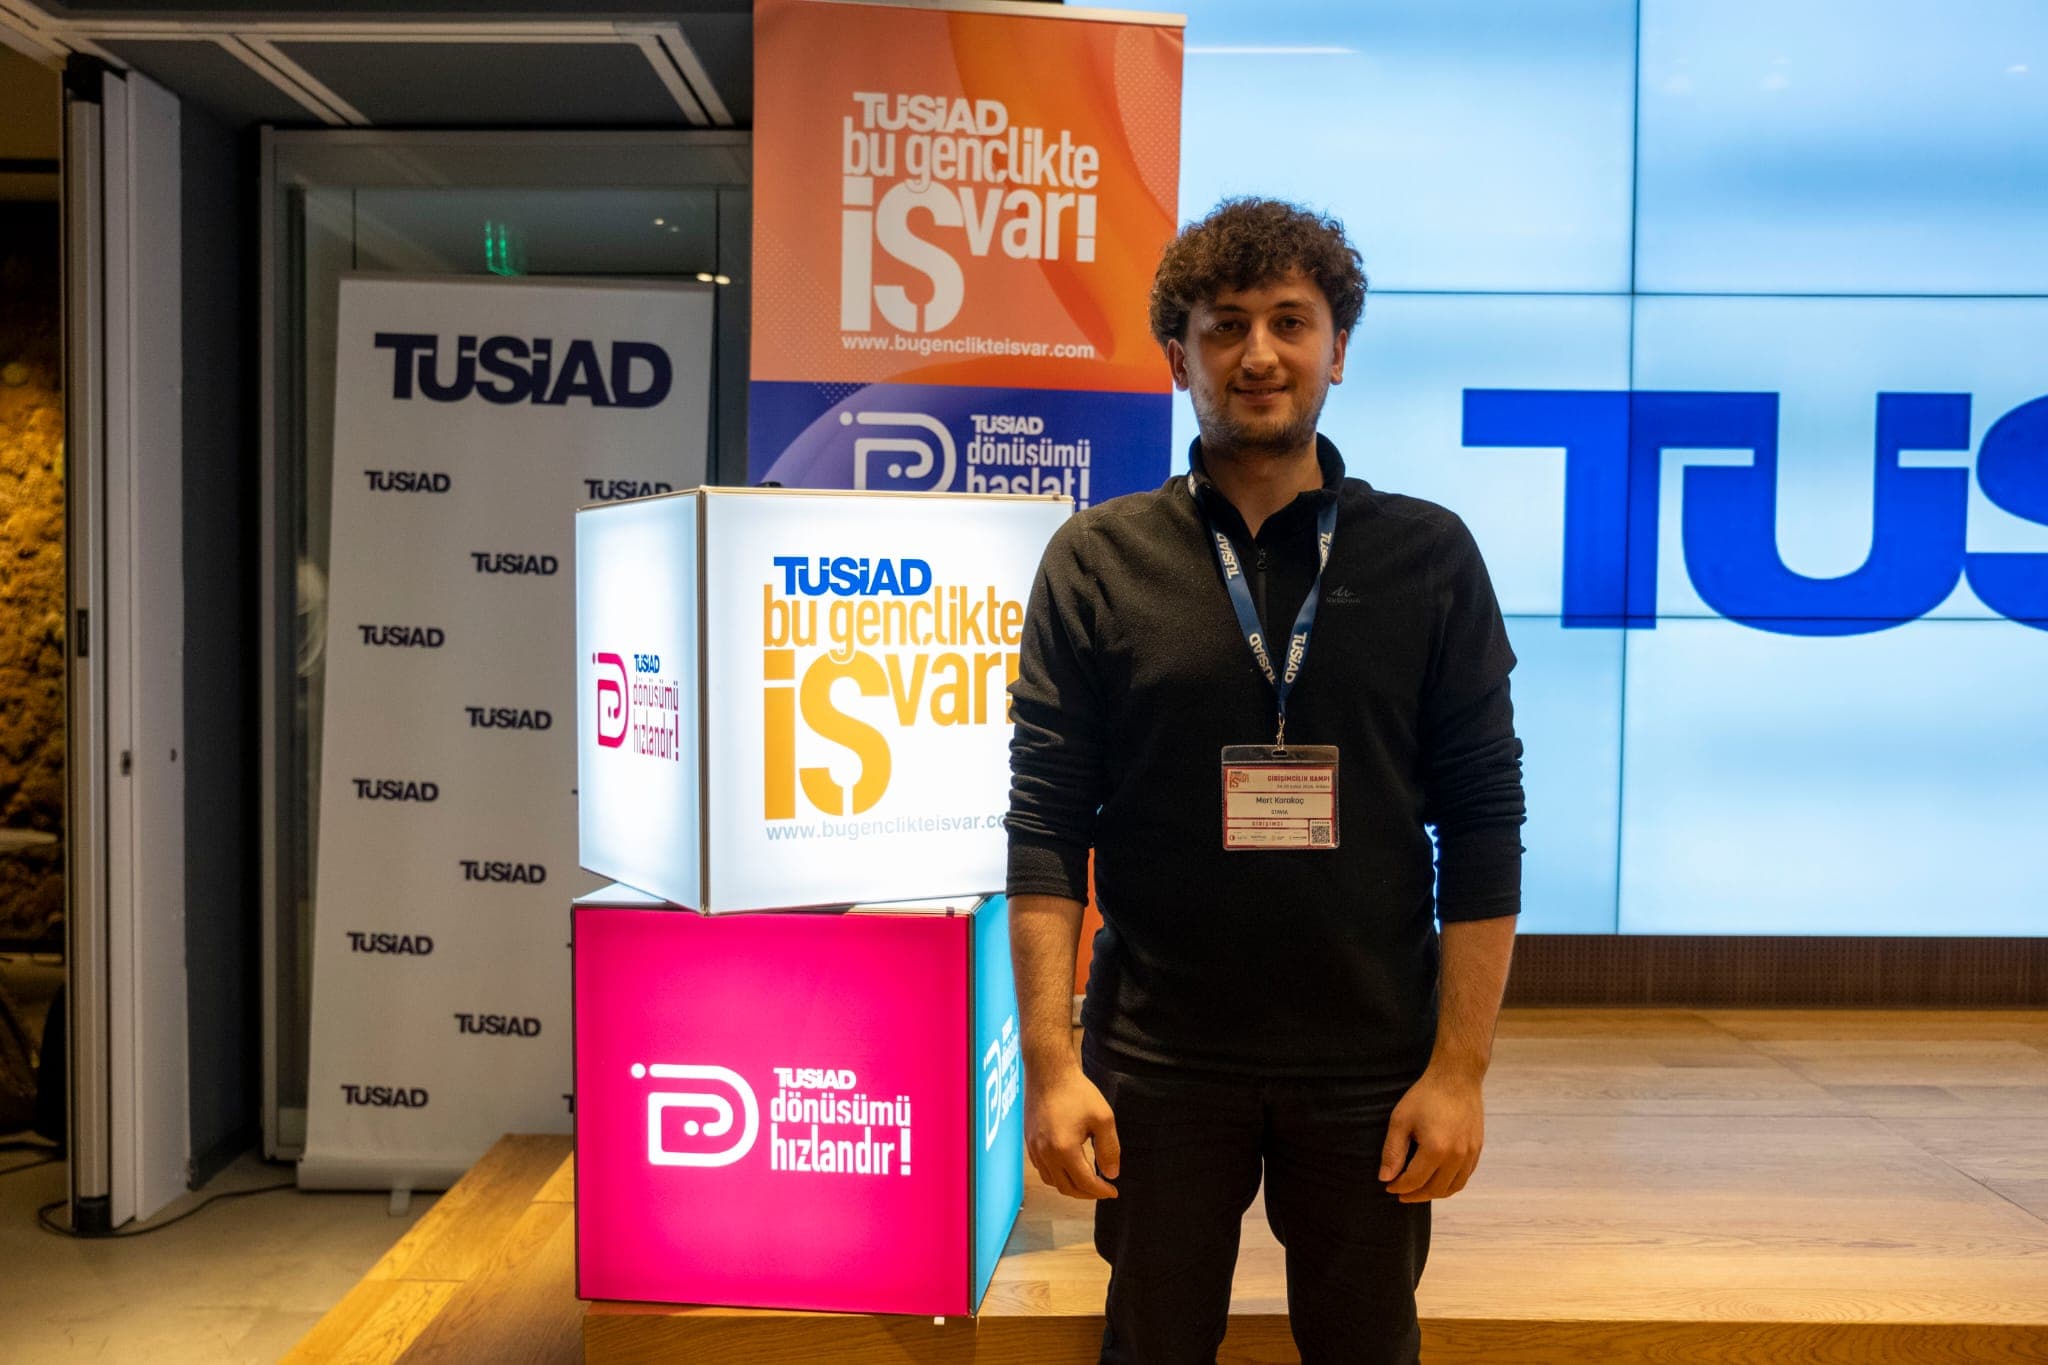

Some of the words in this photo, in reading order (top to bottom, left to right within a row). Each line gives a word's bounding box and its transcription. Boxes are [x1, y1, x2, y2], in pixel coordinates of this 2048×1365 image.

[843, 116, 896, 177] bu
[958, 186, 1098, 264] var!
[841, 335, 1096, 359] www.bugenclikteisvar.com
[763, 584, 817, 648] bu
[829, 585, 1024, 659] gençlikte
[766, 811, 1006, 841] www.bugenclikteisvar.co
